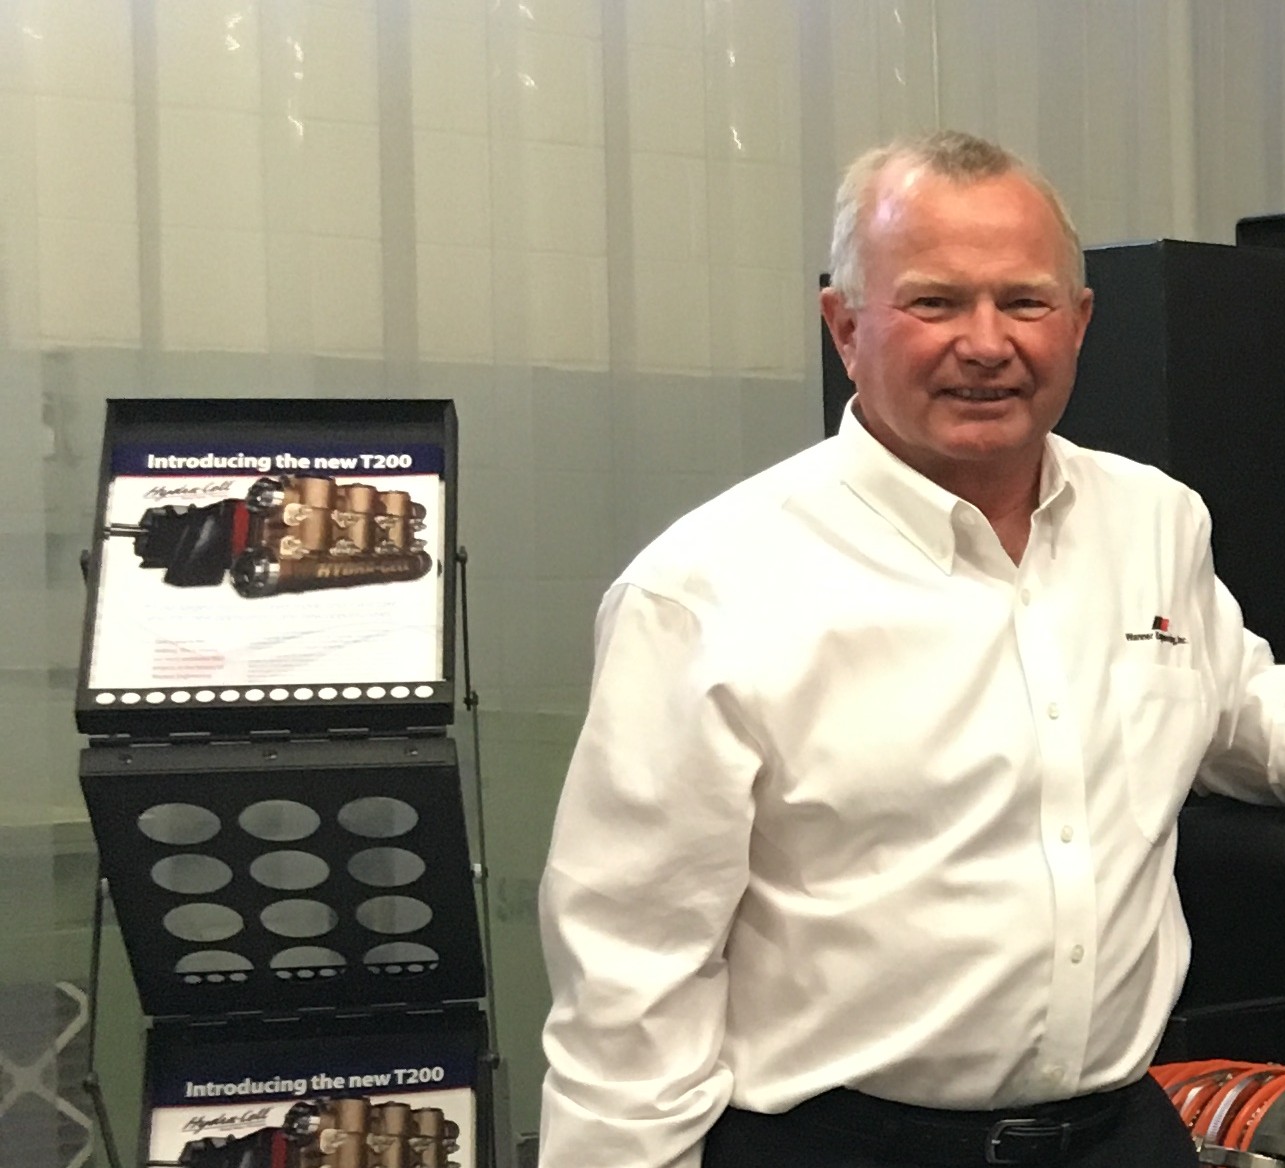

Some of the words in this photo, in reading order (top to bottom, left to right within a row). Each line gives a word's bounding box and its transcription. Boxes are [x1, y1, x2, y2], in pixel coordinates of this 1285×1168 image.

[147, 453, 272, 472] Introducing
[276, 453, 311, 469] the
[315, 457, 358, 469] new
[360, 453, 412, 469] T200
[185, 1078, 307, 1098] Introducing
[311, 1074, 345, 1090] the
[349, 1072, 391, 1087] new
[394, 1066, 444, 1084] T200
